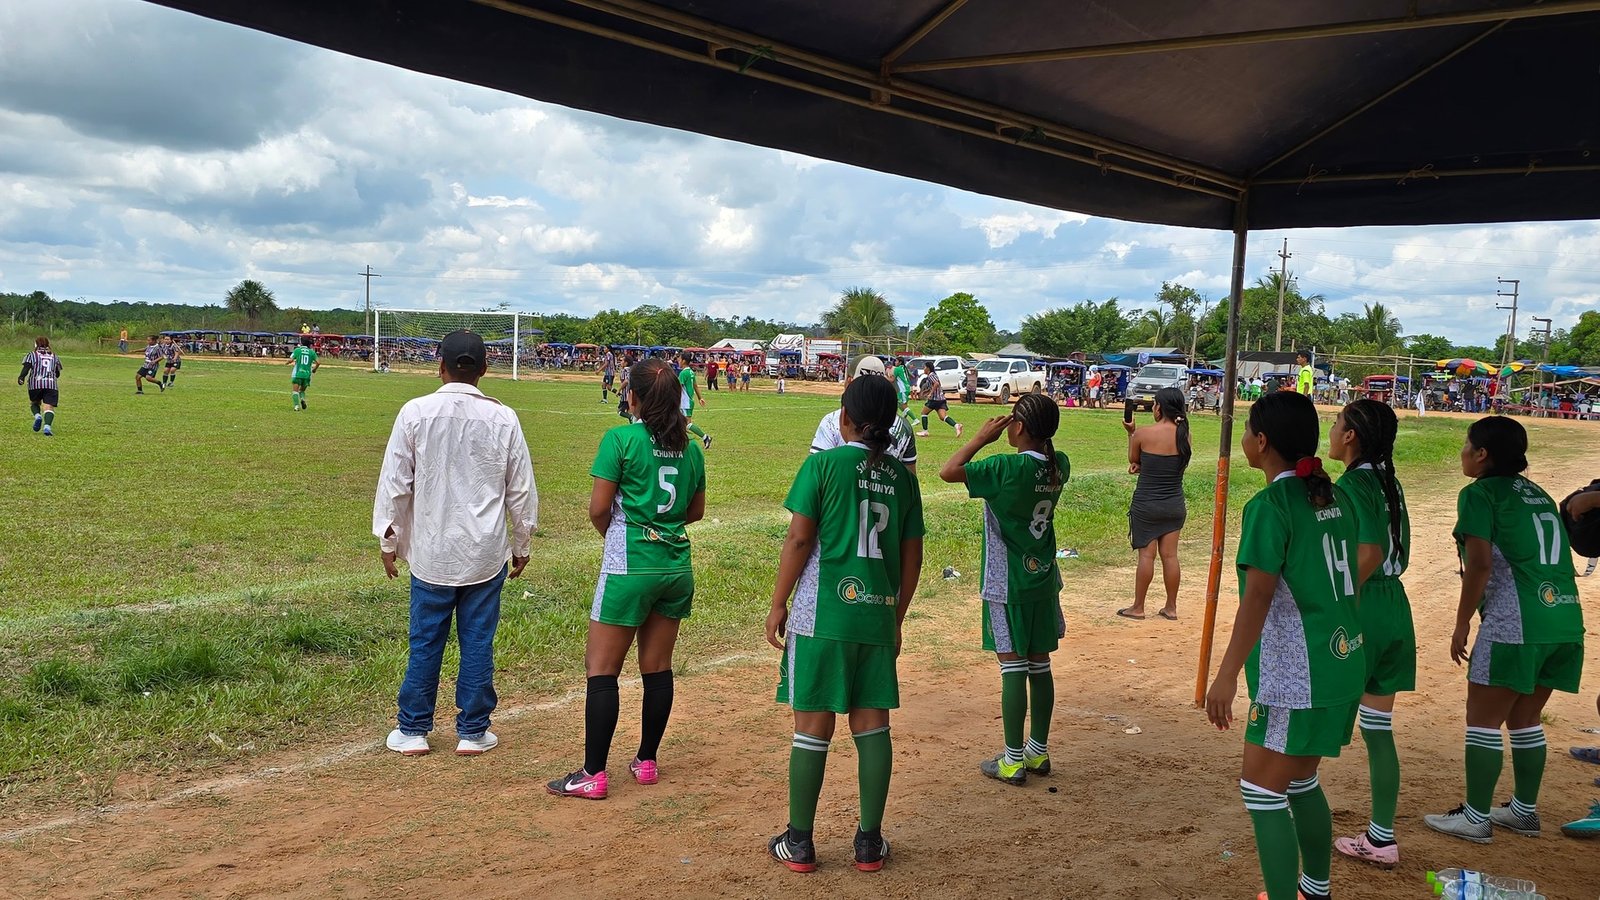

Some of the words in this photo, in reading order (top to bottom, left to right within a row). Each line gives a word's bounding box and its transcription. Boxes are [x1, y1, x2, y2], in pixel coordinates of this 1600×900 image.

[42, 357, 50, 372] 9
[300, 354, 309, 365] 10
[652, 448, 684, 459] UCHUNYA
[870, 470, 882, 481] DE
[657, 465, 679, 514] 5
[858, 479, 896, 496] UCHUNYA
[1029, 499, 1053, 540] 8
[857, 498, 890, 560] 12
[1532, 512, 1562, 565] 17
[1322, 532, 1355, 602] 14
[855, 592, 885, 605] OCHO
[583, 781, 598, 793] CR7
